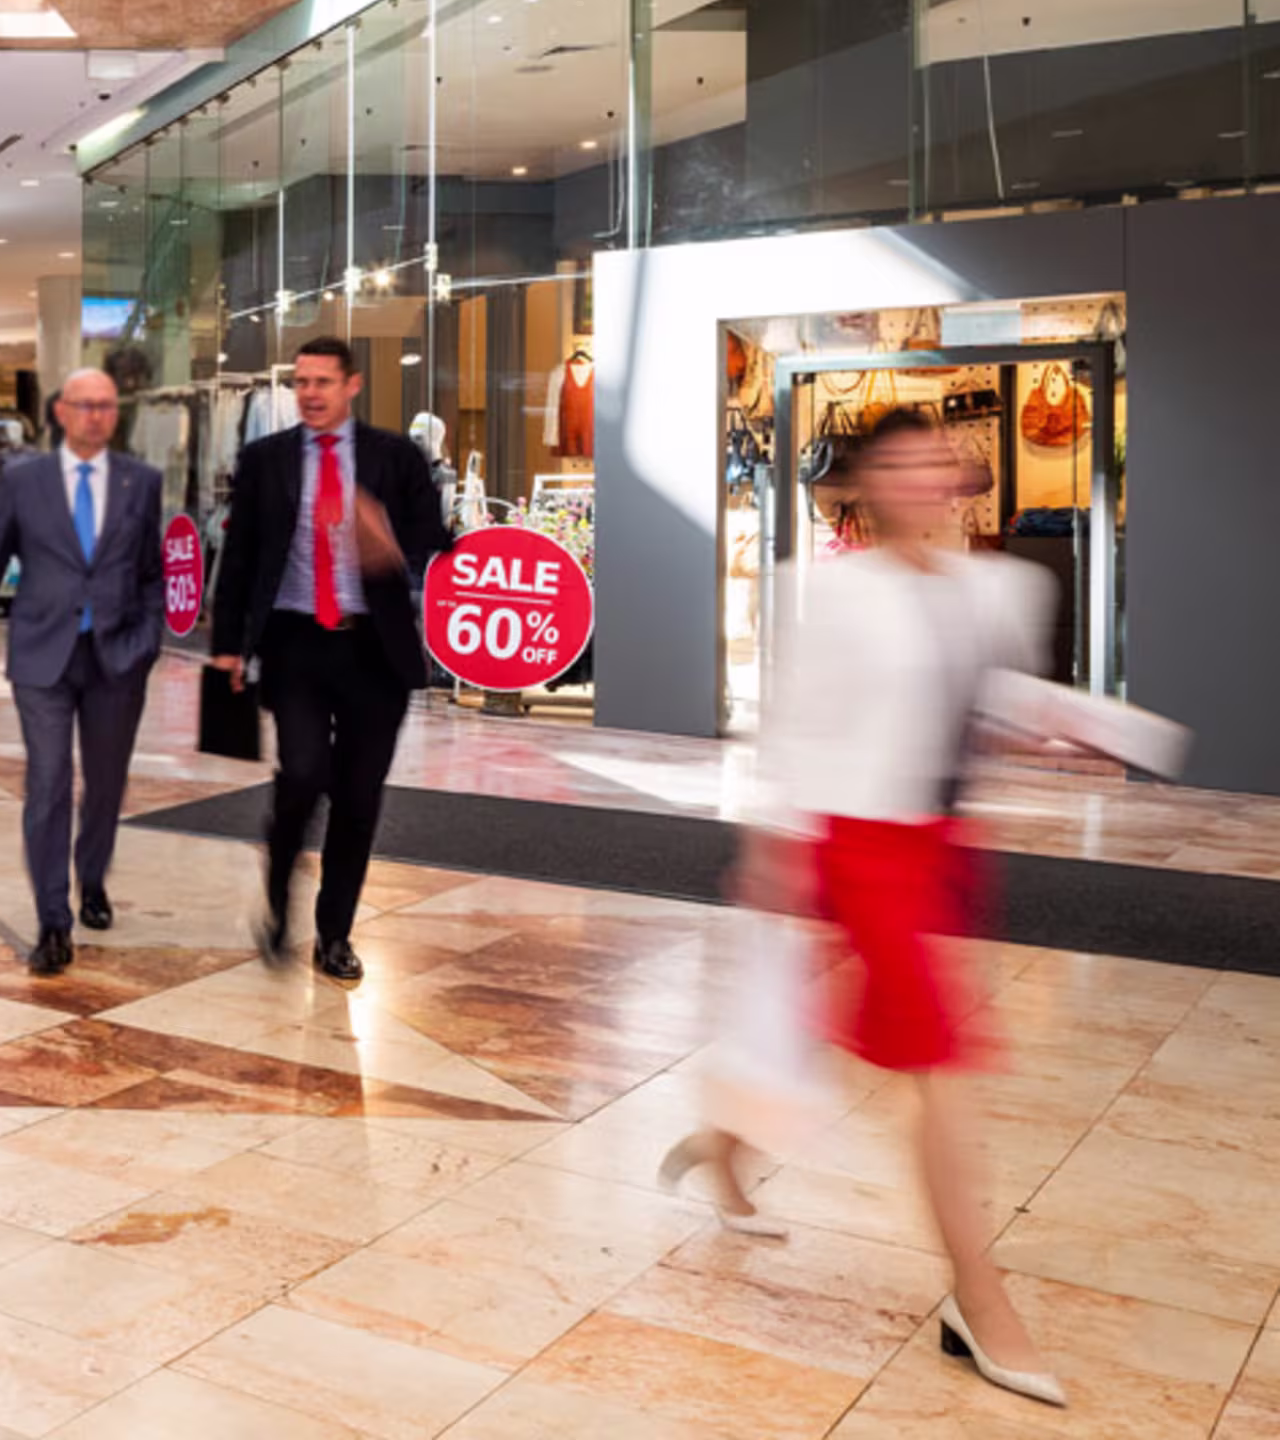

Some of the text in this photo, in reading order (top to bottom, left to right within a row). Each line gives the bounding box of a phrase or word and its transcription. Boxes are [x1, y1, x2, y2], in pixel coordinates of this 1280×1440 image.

[452, 553, 561, 595] SALE
[447, 604, 560, 660] 60%
[521, 645, 558, 665] OFF
